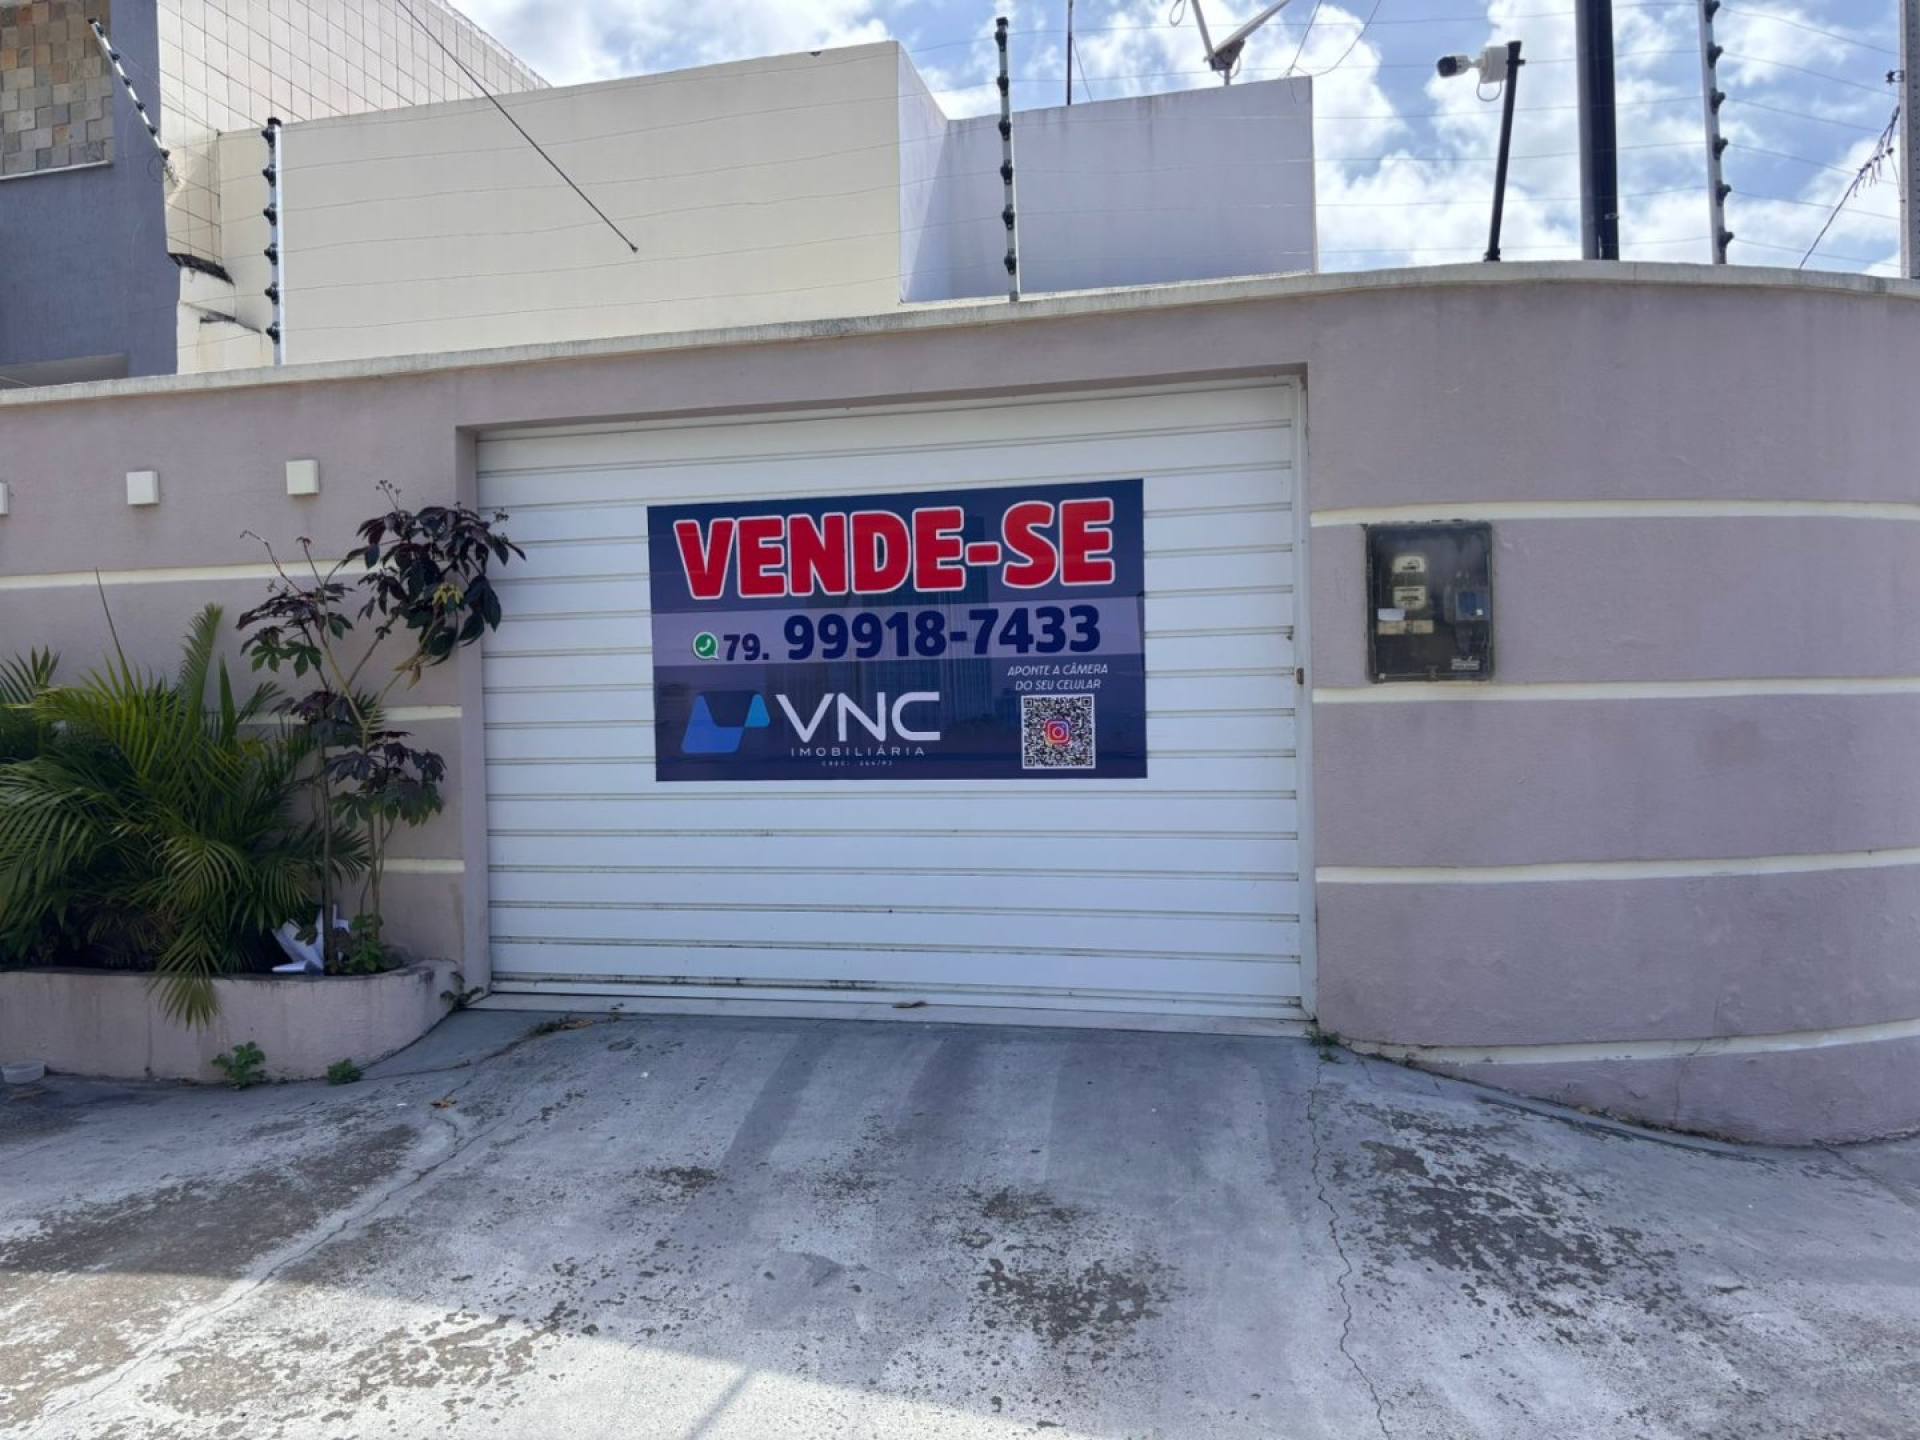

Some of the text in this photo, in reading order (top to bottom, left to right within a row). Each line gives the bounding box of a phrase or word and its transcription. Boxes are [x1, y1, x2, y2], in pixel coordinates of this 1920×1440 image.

[674, 498, 1115, 599] VENDE-SE
[723, 605, 1101, 661] 79. 99918-7433
[1007, 662, 1109, 677] APONTE A CÂMERA
[1015, 679, 1102, 691] DO SEU CELULAR
[775, 691, 941, 743] VNC
[791, 745, 926, 757] IMOBILIÁRIA
